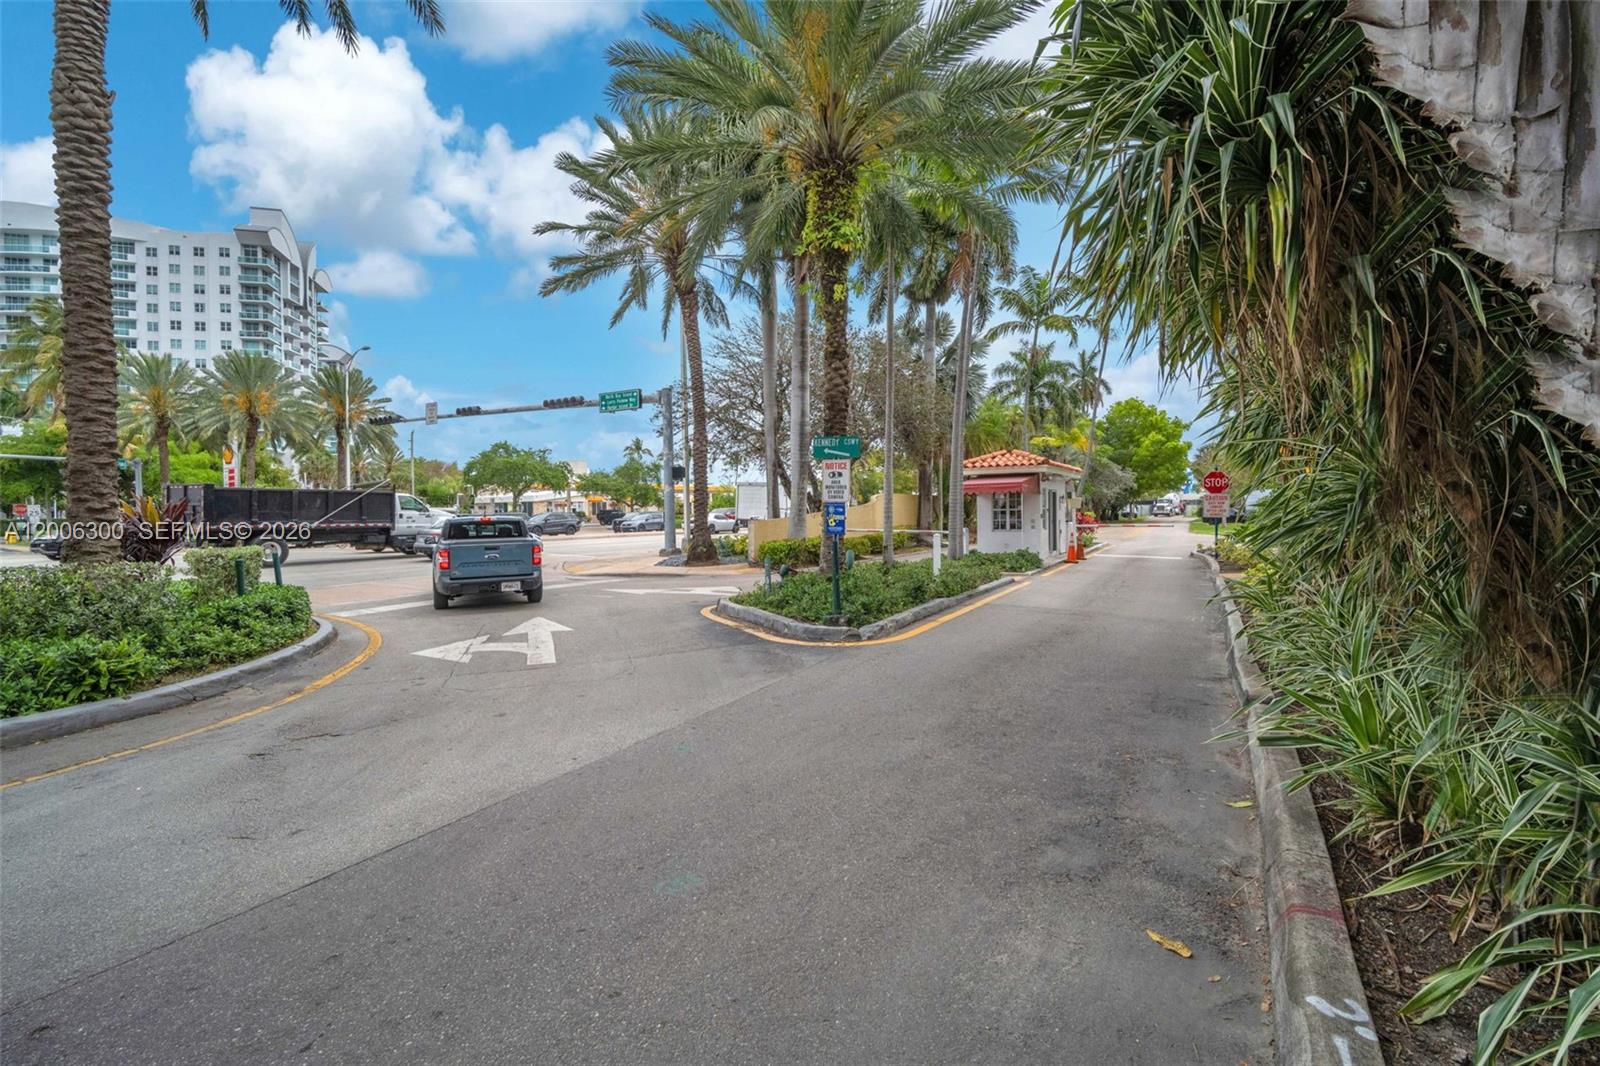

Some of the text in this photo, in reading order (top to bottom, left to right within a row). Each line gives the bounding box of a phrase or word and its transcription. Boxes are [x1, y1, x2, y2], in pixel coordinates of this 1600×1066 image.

[814, 438, 860, 447] KENNEDY CSWY
[825, 462, 848, 470] NOTICE
[1205, 478, 1228, 488] STOP
